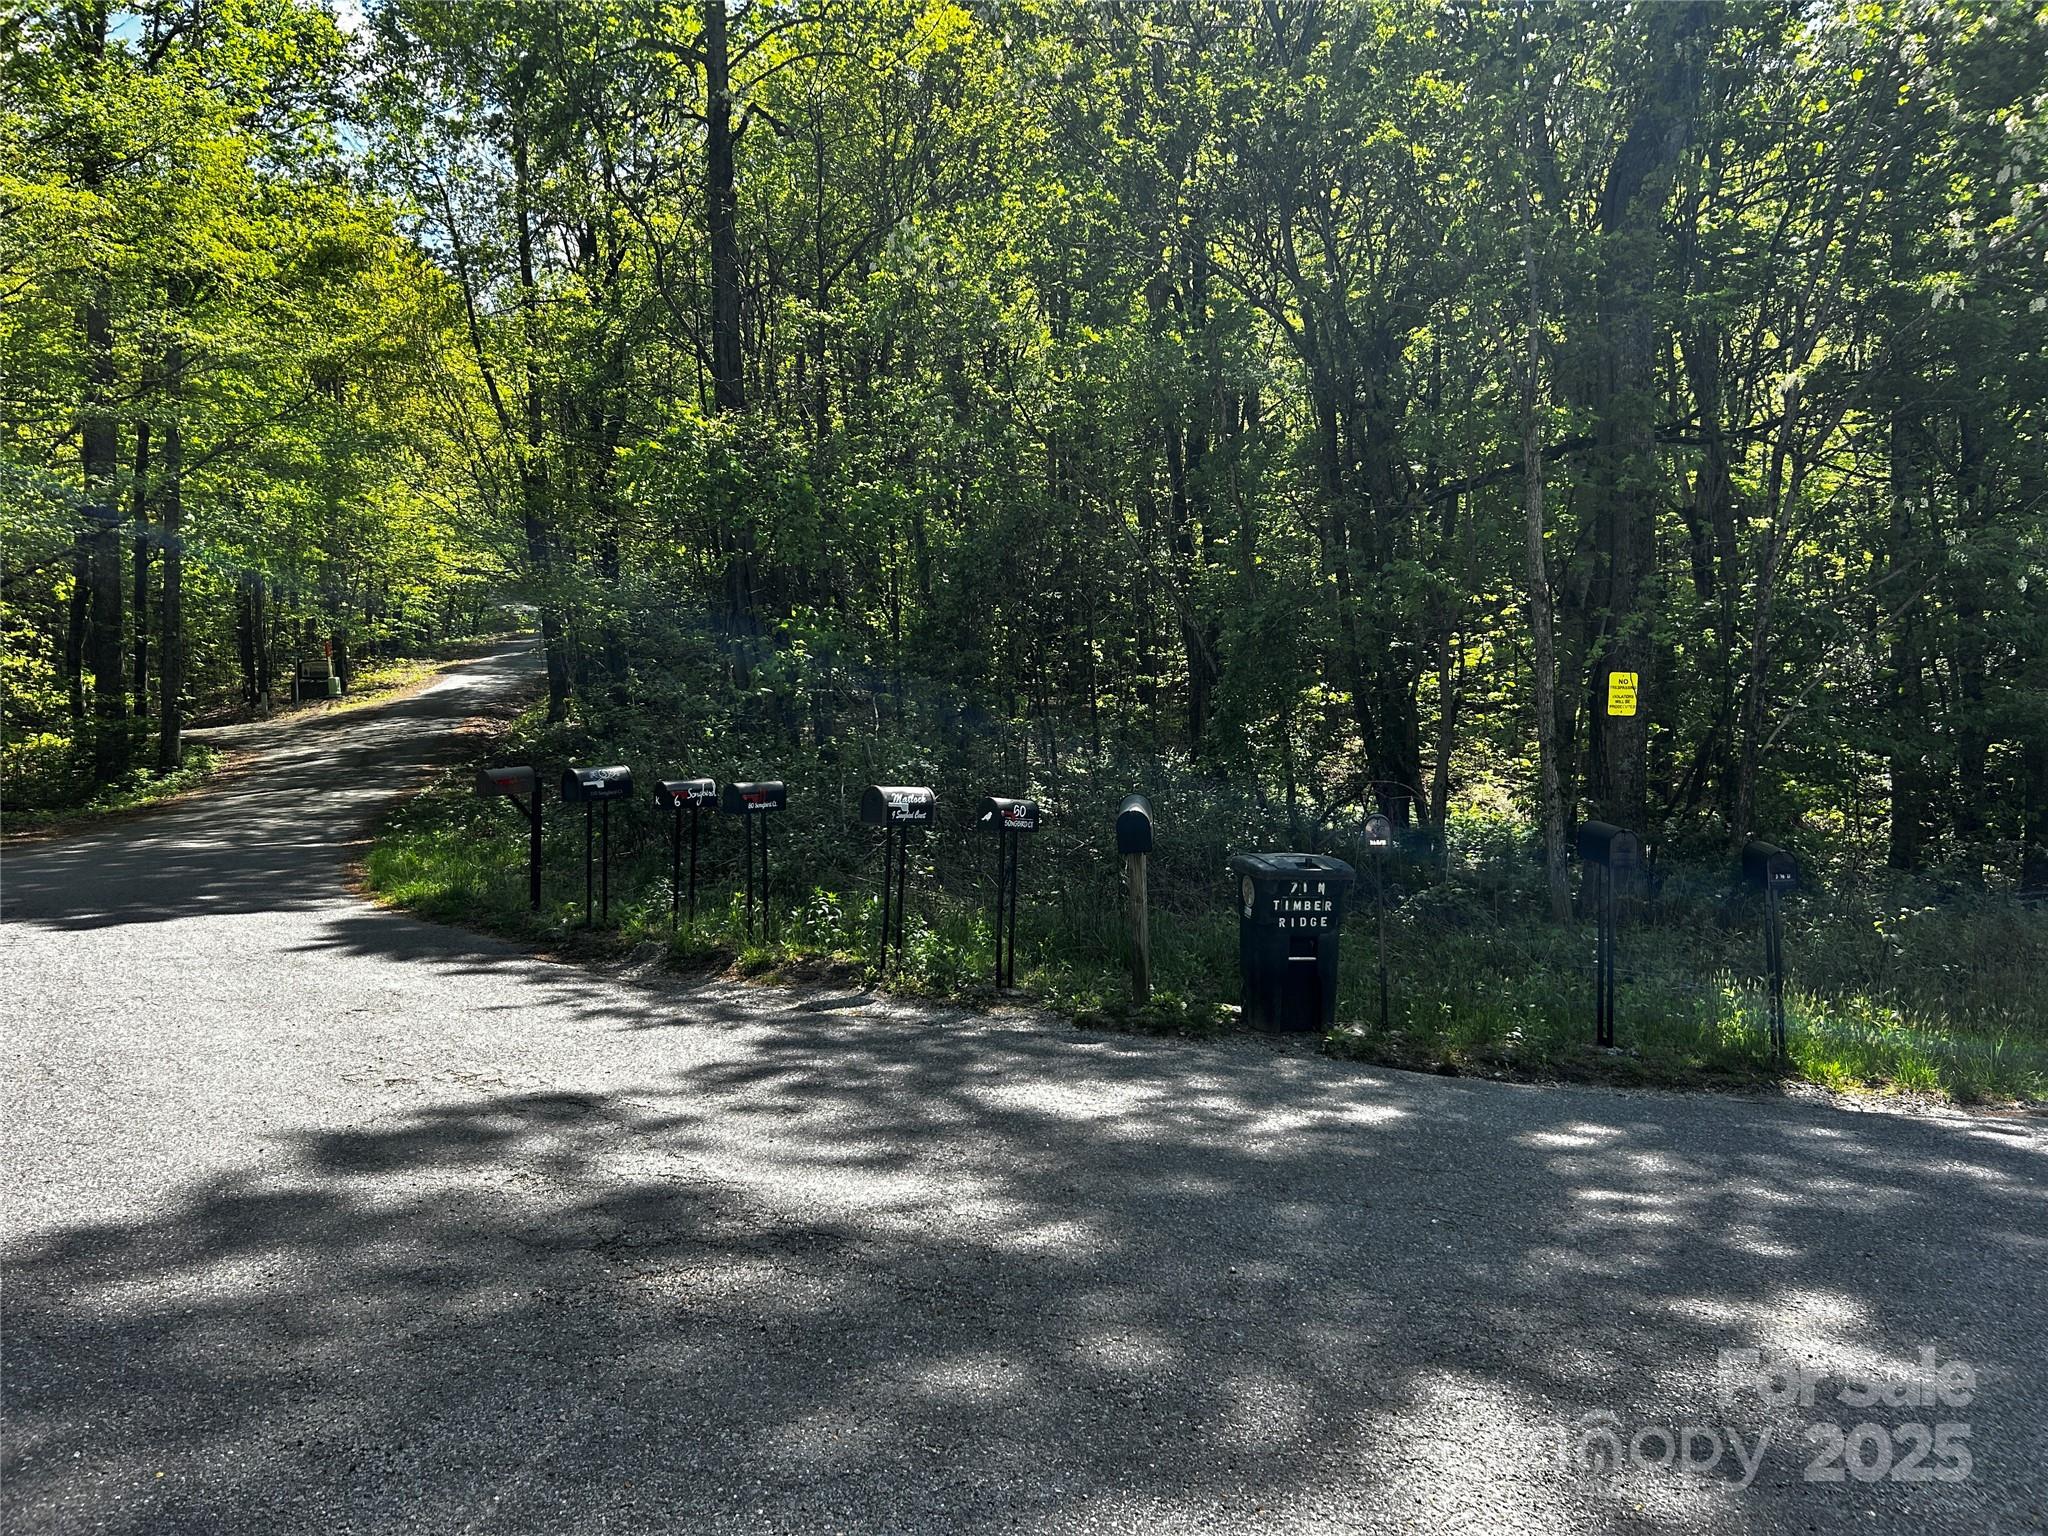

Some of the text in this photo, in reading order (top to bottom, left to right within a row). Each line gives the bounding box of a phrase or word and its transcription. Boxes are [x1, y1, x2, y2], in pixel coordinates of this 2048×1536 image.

[674, 781, 717, 807] 6 Songbird
[891, 792, 927, 804] Matlock
[1273, 900, 1333, 912] TIMBER
[1278, 916, 1328, 928] RIDGE
